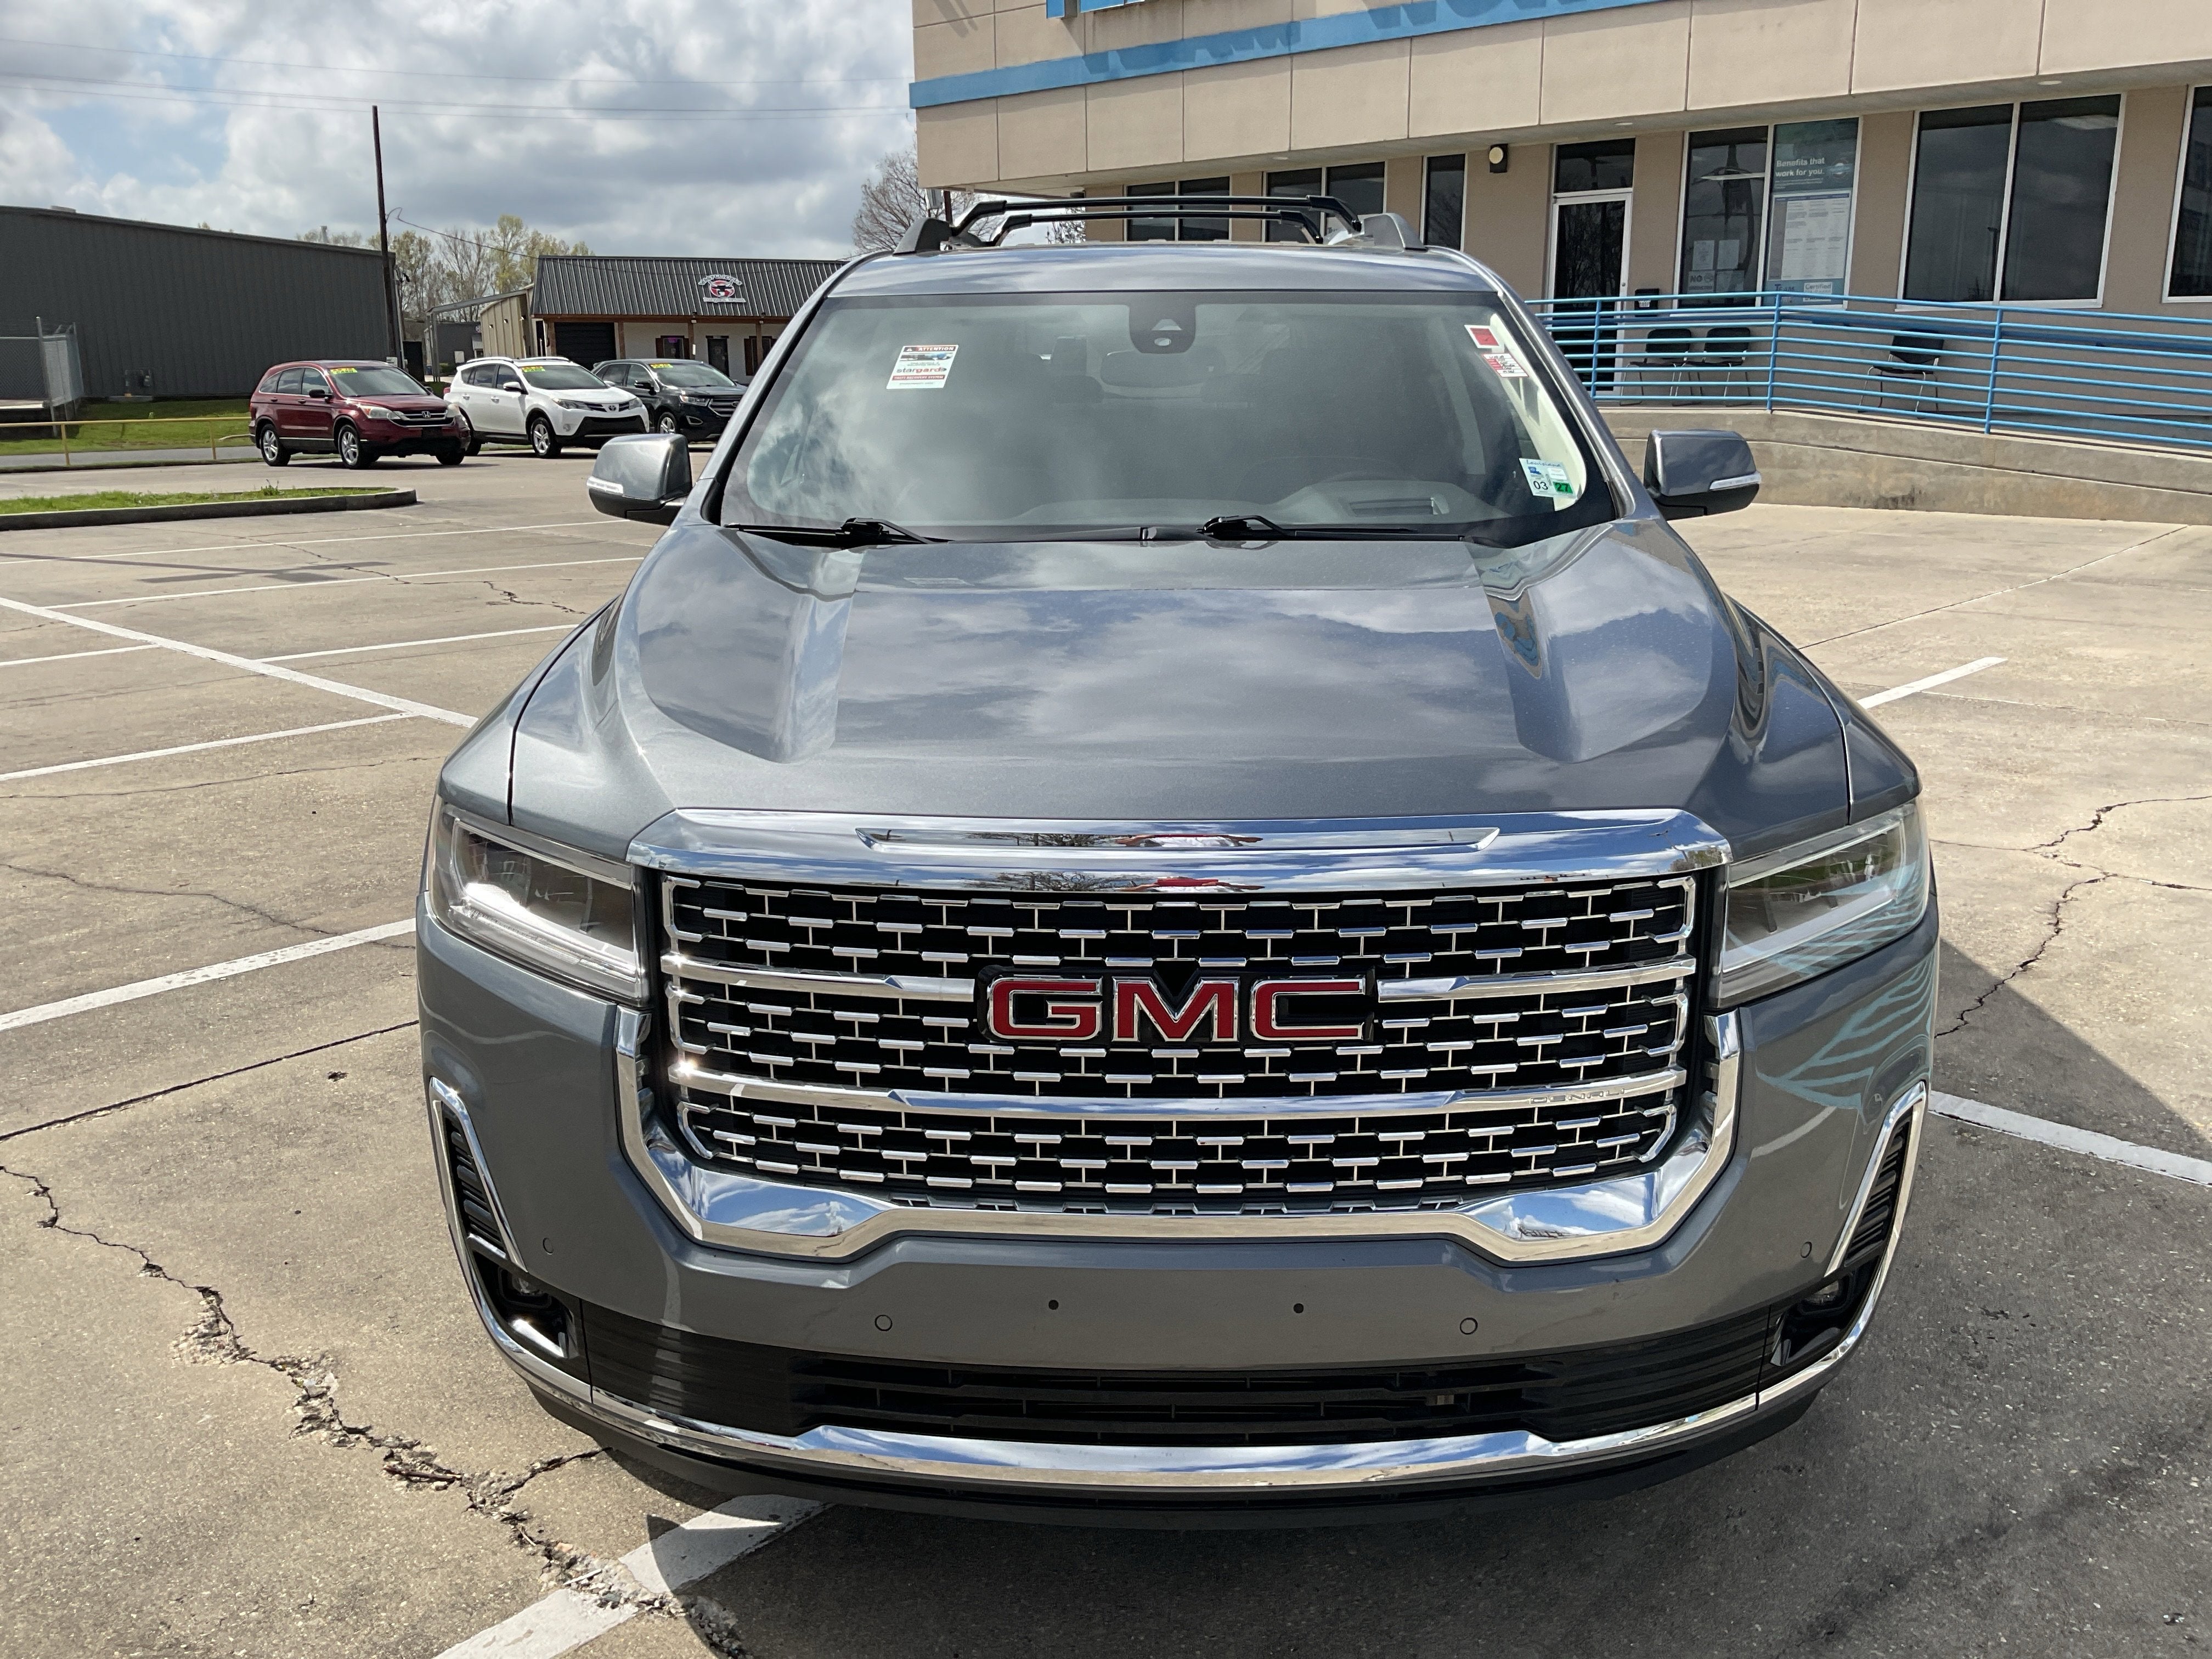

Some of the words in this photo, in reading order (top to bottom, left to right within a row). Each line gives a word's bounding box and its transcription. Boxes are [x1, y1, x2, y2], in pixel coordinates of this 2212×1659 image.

[1776, 159, 1808, 167] Benefits
[1810, 157, 1825, 165] that
[1808, 168, 1825, 177] you.
[1690, 275, 1703, 283] NO
[1526, 459, 1562, 467] Louisiana
[1533, 481, 1549, 490] 03
[1555, 482, 1570, 492] 27
[988, 976, 1367, 1042] GMC
[1529, 1088, 1626, 1105] DENALI
